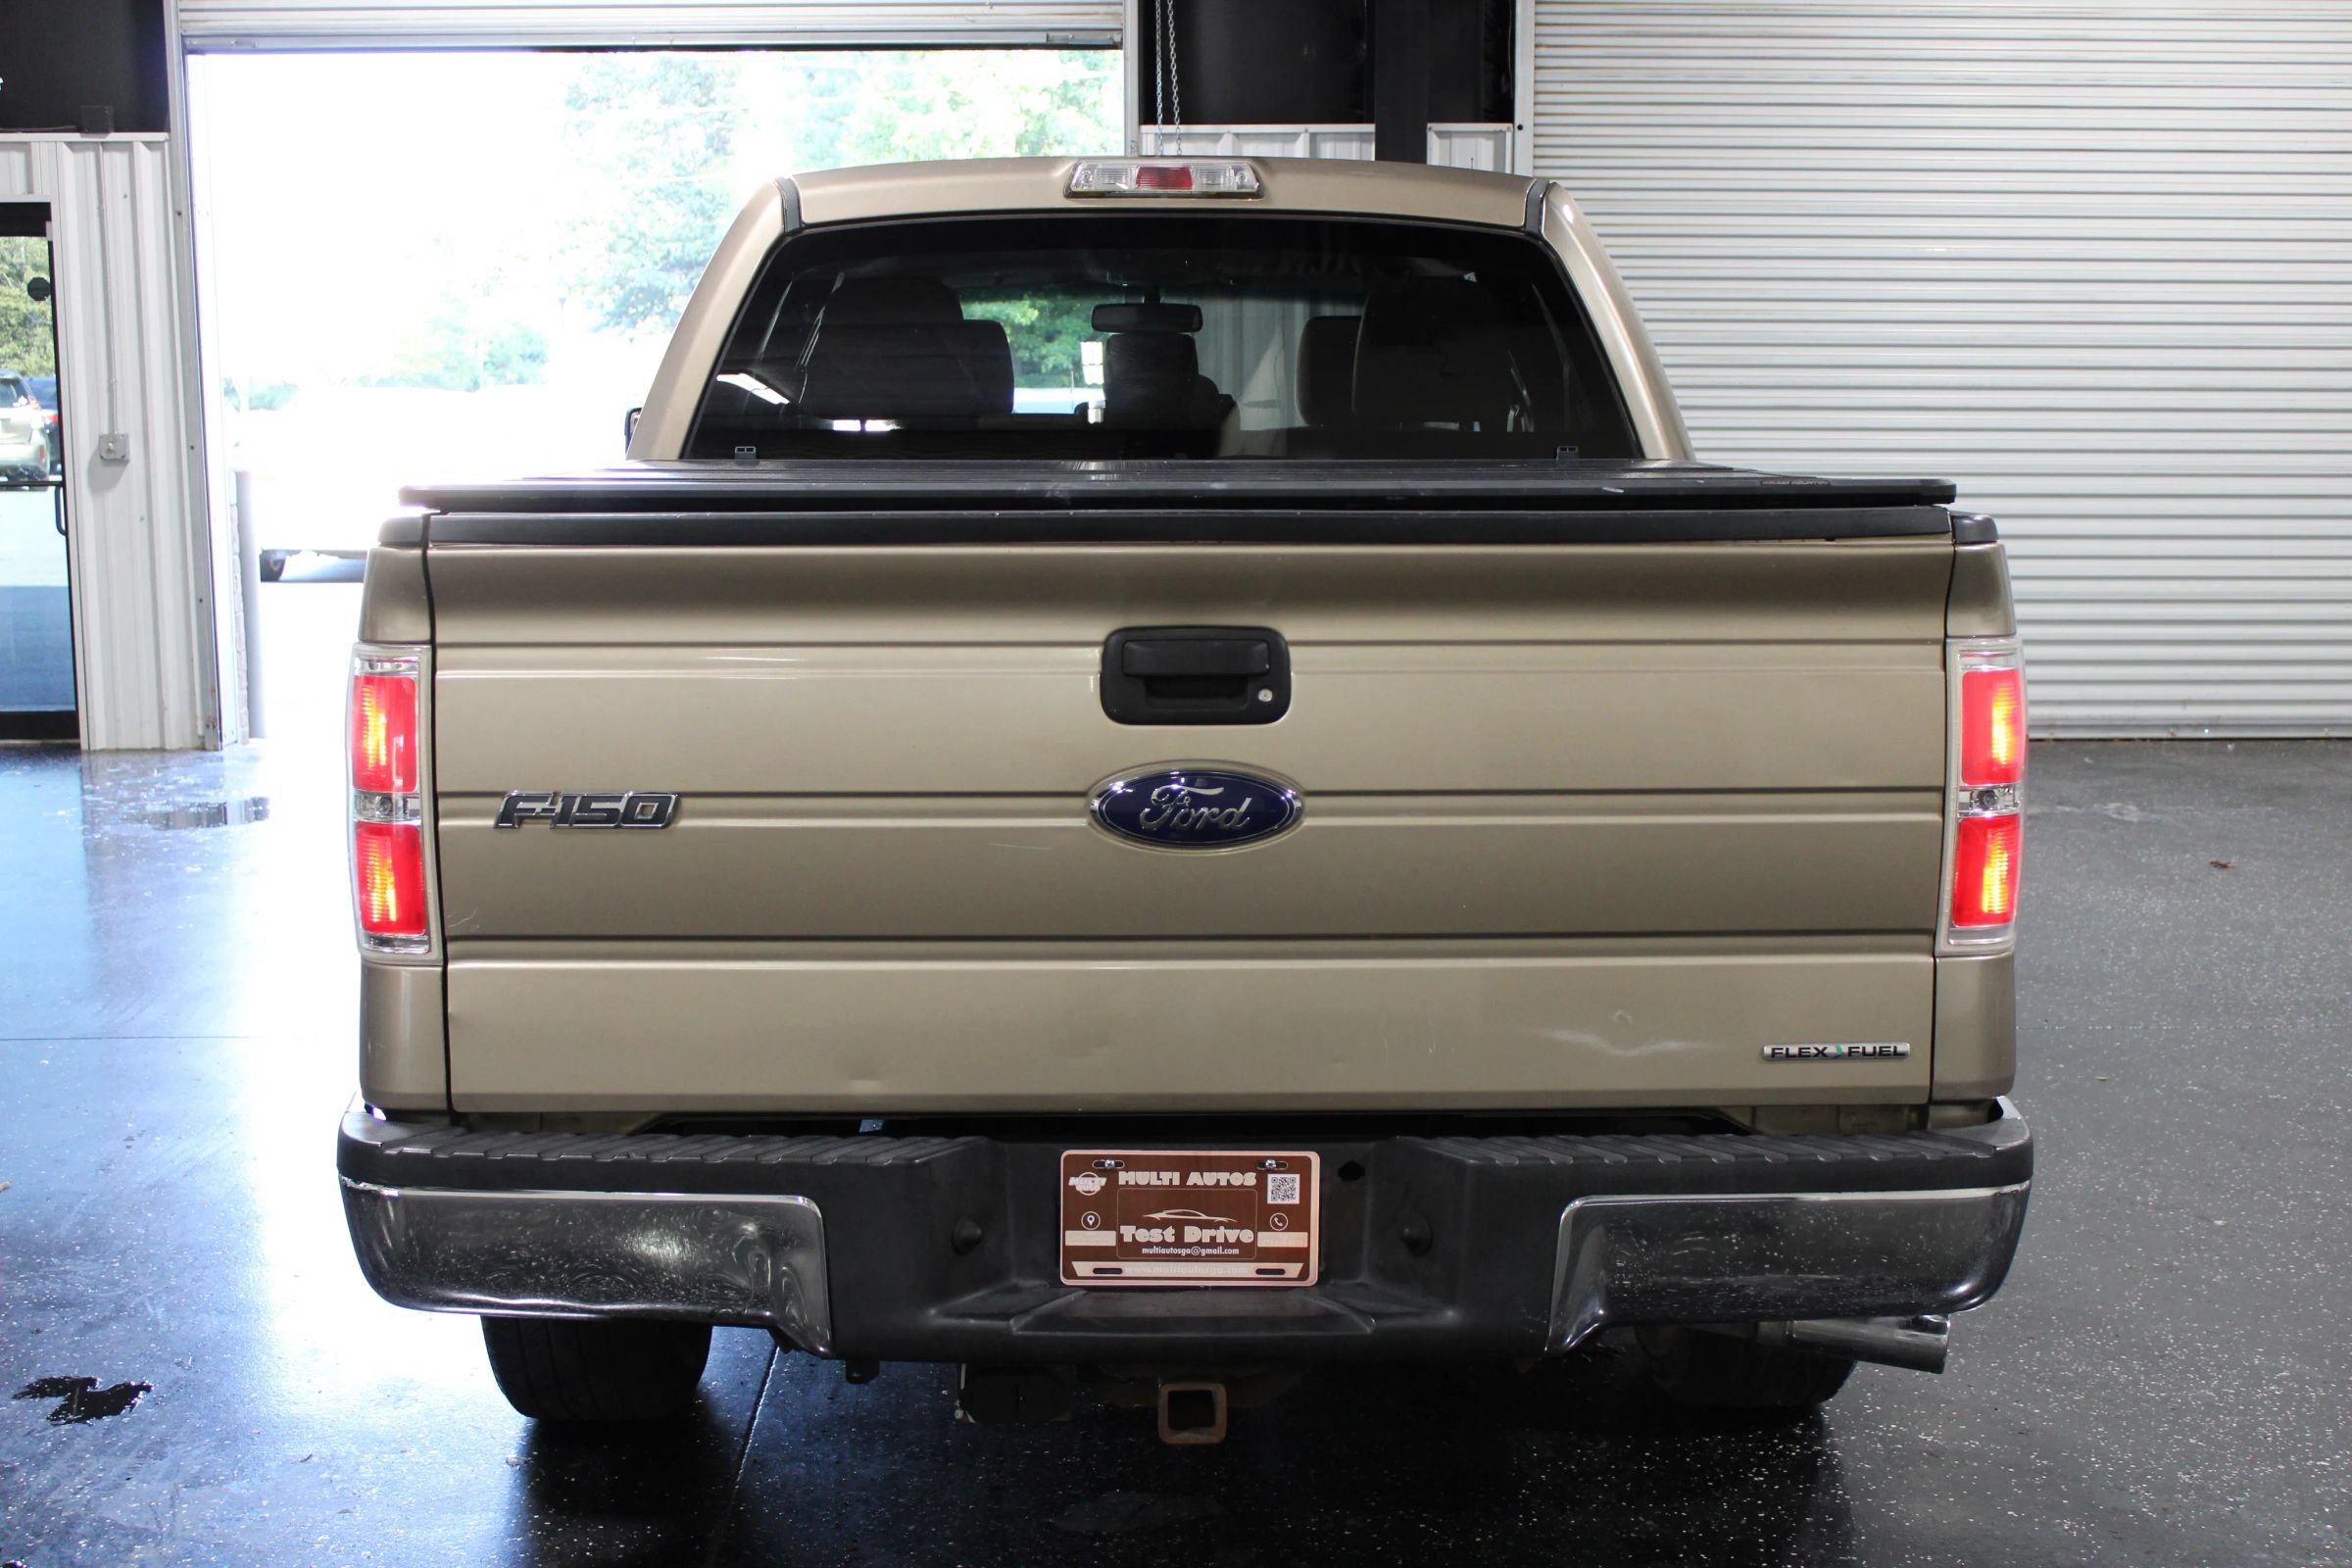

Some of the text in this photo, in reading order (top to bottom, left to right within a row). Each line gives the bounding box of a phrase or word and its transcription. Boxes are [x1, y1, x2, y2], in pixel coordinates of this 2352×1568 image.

[494, 790, 679, 829] F-150
[1139, 783, 1252, 830] Ford
[1771, 1045, 1905, 1058] FLEX FUEL
[1118, 1171, 1256, 1186] MULTI AUTOS
[1120, 1225, 1175, 1243] Test
[1184, 1226, 1253, 1243] Drive
[1142, 1246, 1239, 1256] multiautosga@gmail.com
